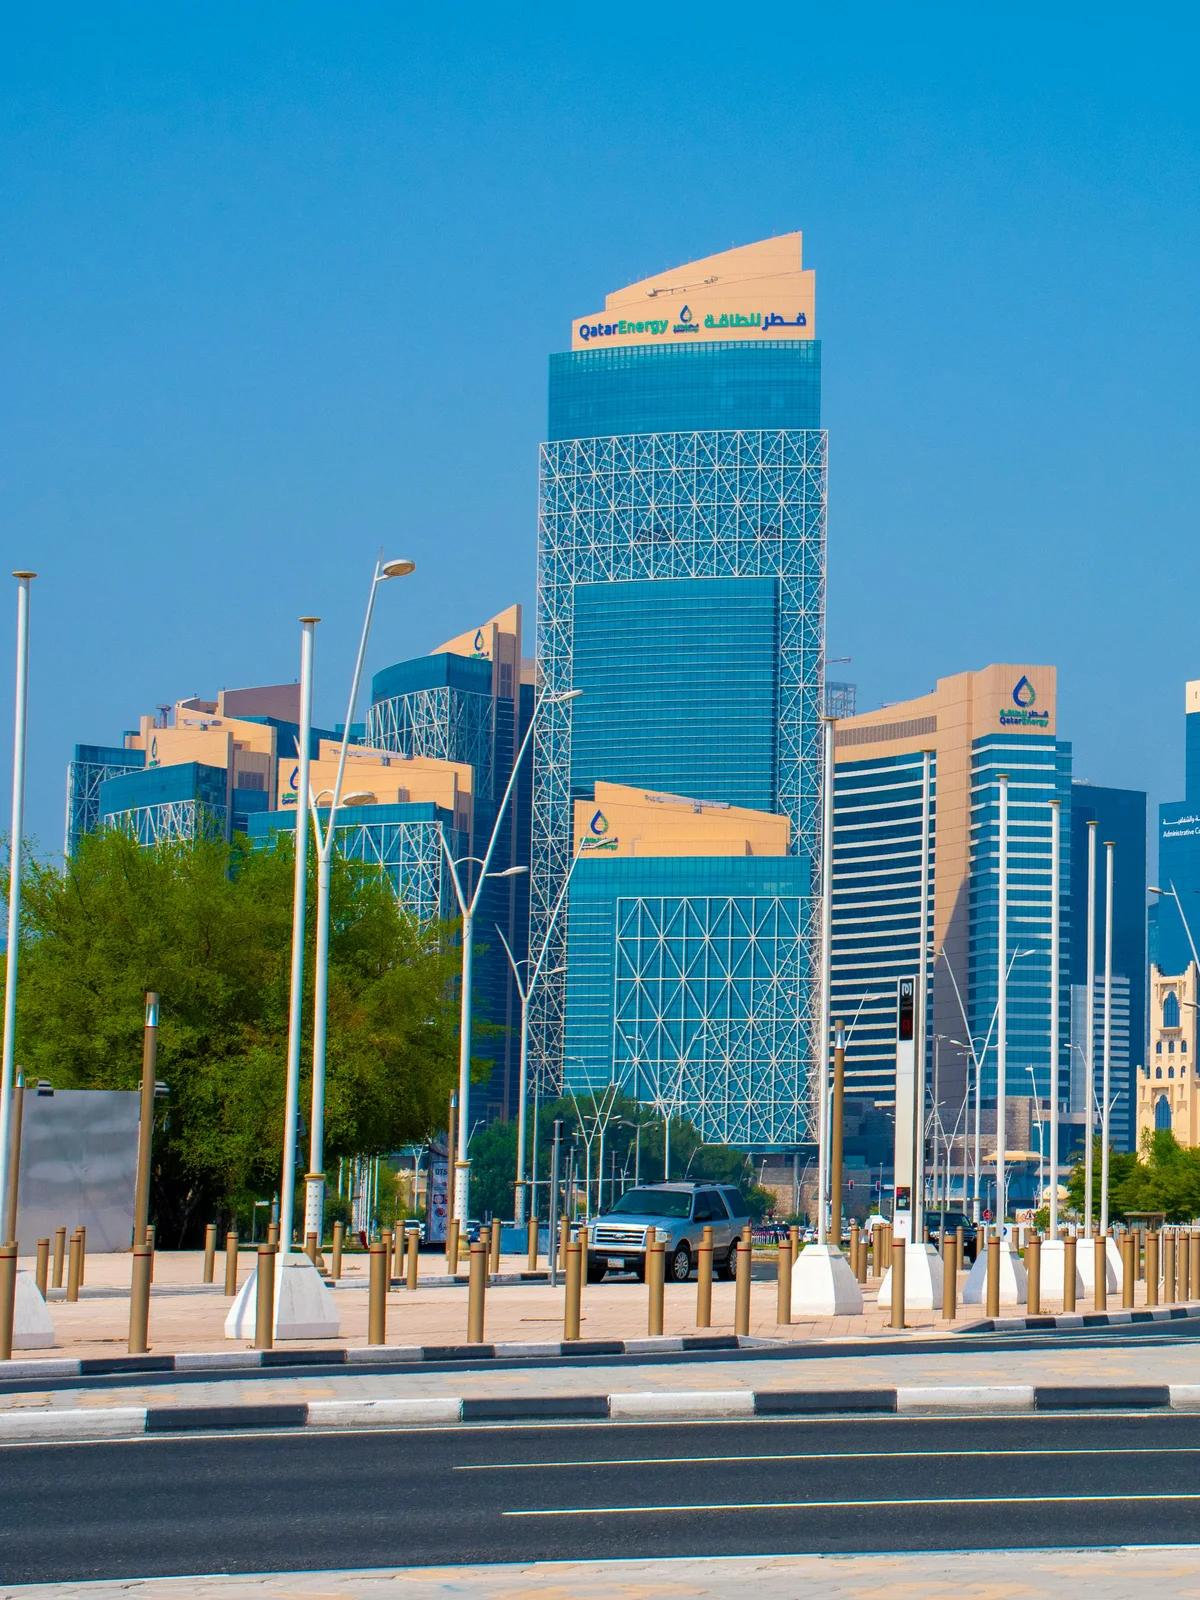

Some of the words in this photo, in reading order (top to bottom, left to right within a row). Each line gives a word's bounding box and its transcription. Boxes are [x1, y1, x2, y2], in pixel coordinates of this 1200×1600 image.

[703, 313, 761, 329] للطاقة
[762, 312, 807, 331] قطر
[579, 320, 669, 341] QatarEnergy
[1163, 829, 1195, 838] Administrative
